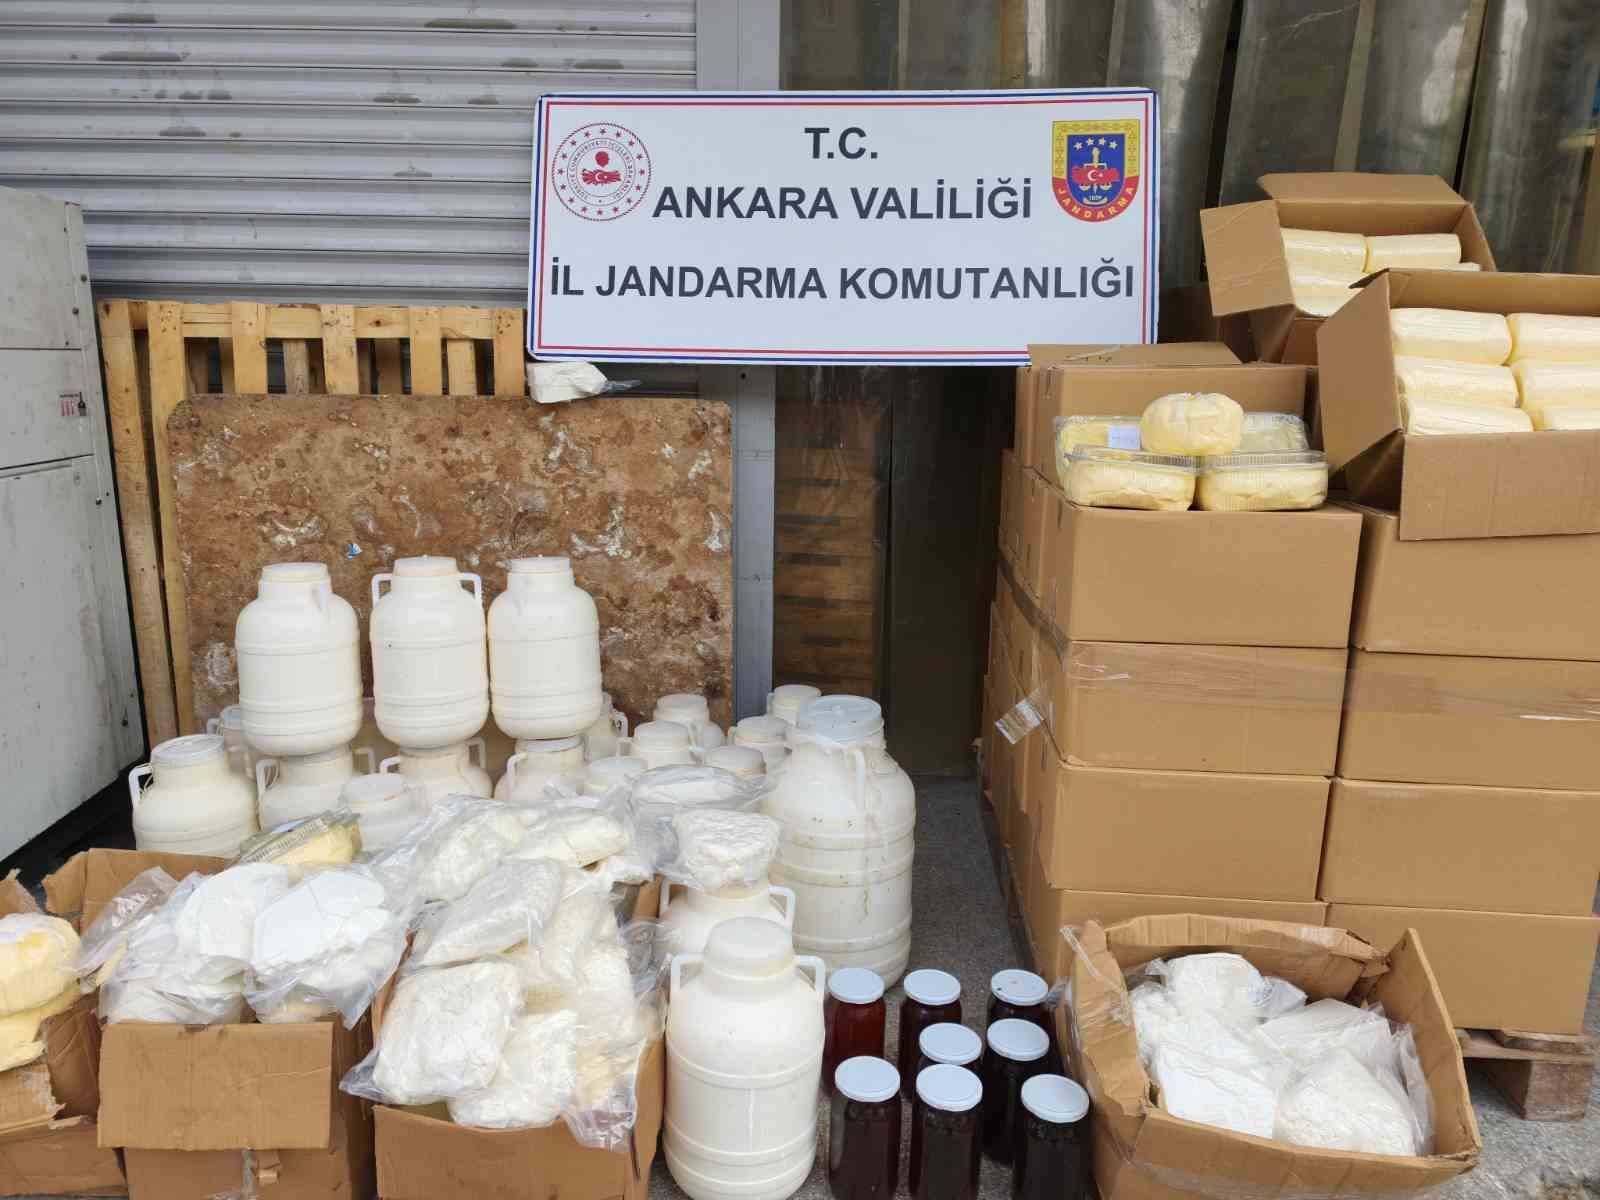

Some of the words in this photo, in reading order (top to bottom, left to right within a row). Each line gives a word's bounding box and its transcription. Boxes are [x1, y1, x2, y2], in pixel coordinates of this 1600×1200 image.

[804, 127, 878, 160] T.C.
[652, 186, 839, 219] ANKARA
[850, 177, 1032, 220] VALİLİĞİ
[1057, 186, 1135, 221] JANDARMA
[551, 256, 584, 296] İL
[595, 265, 827, 299] JANDARMA
[839, 257, 1134, 300] KOMUTANLIĞI
